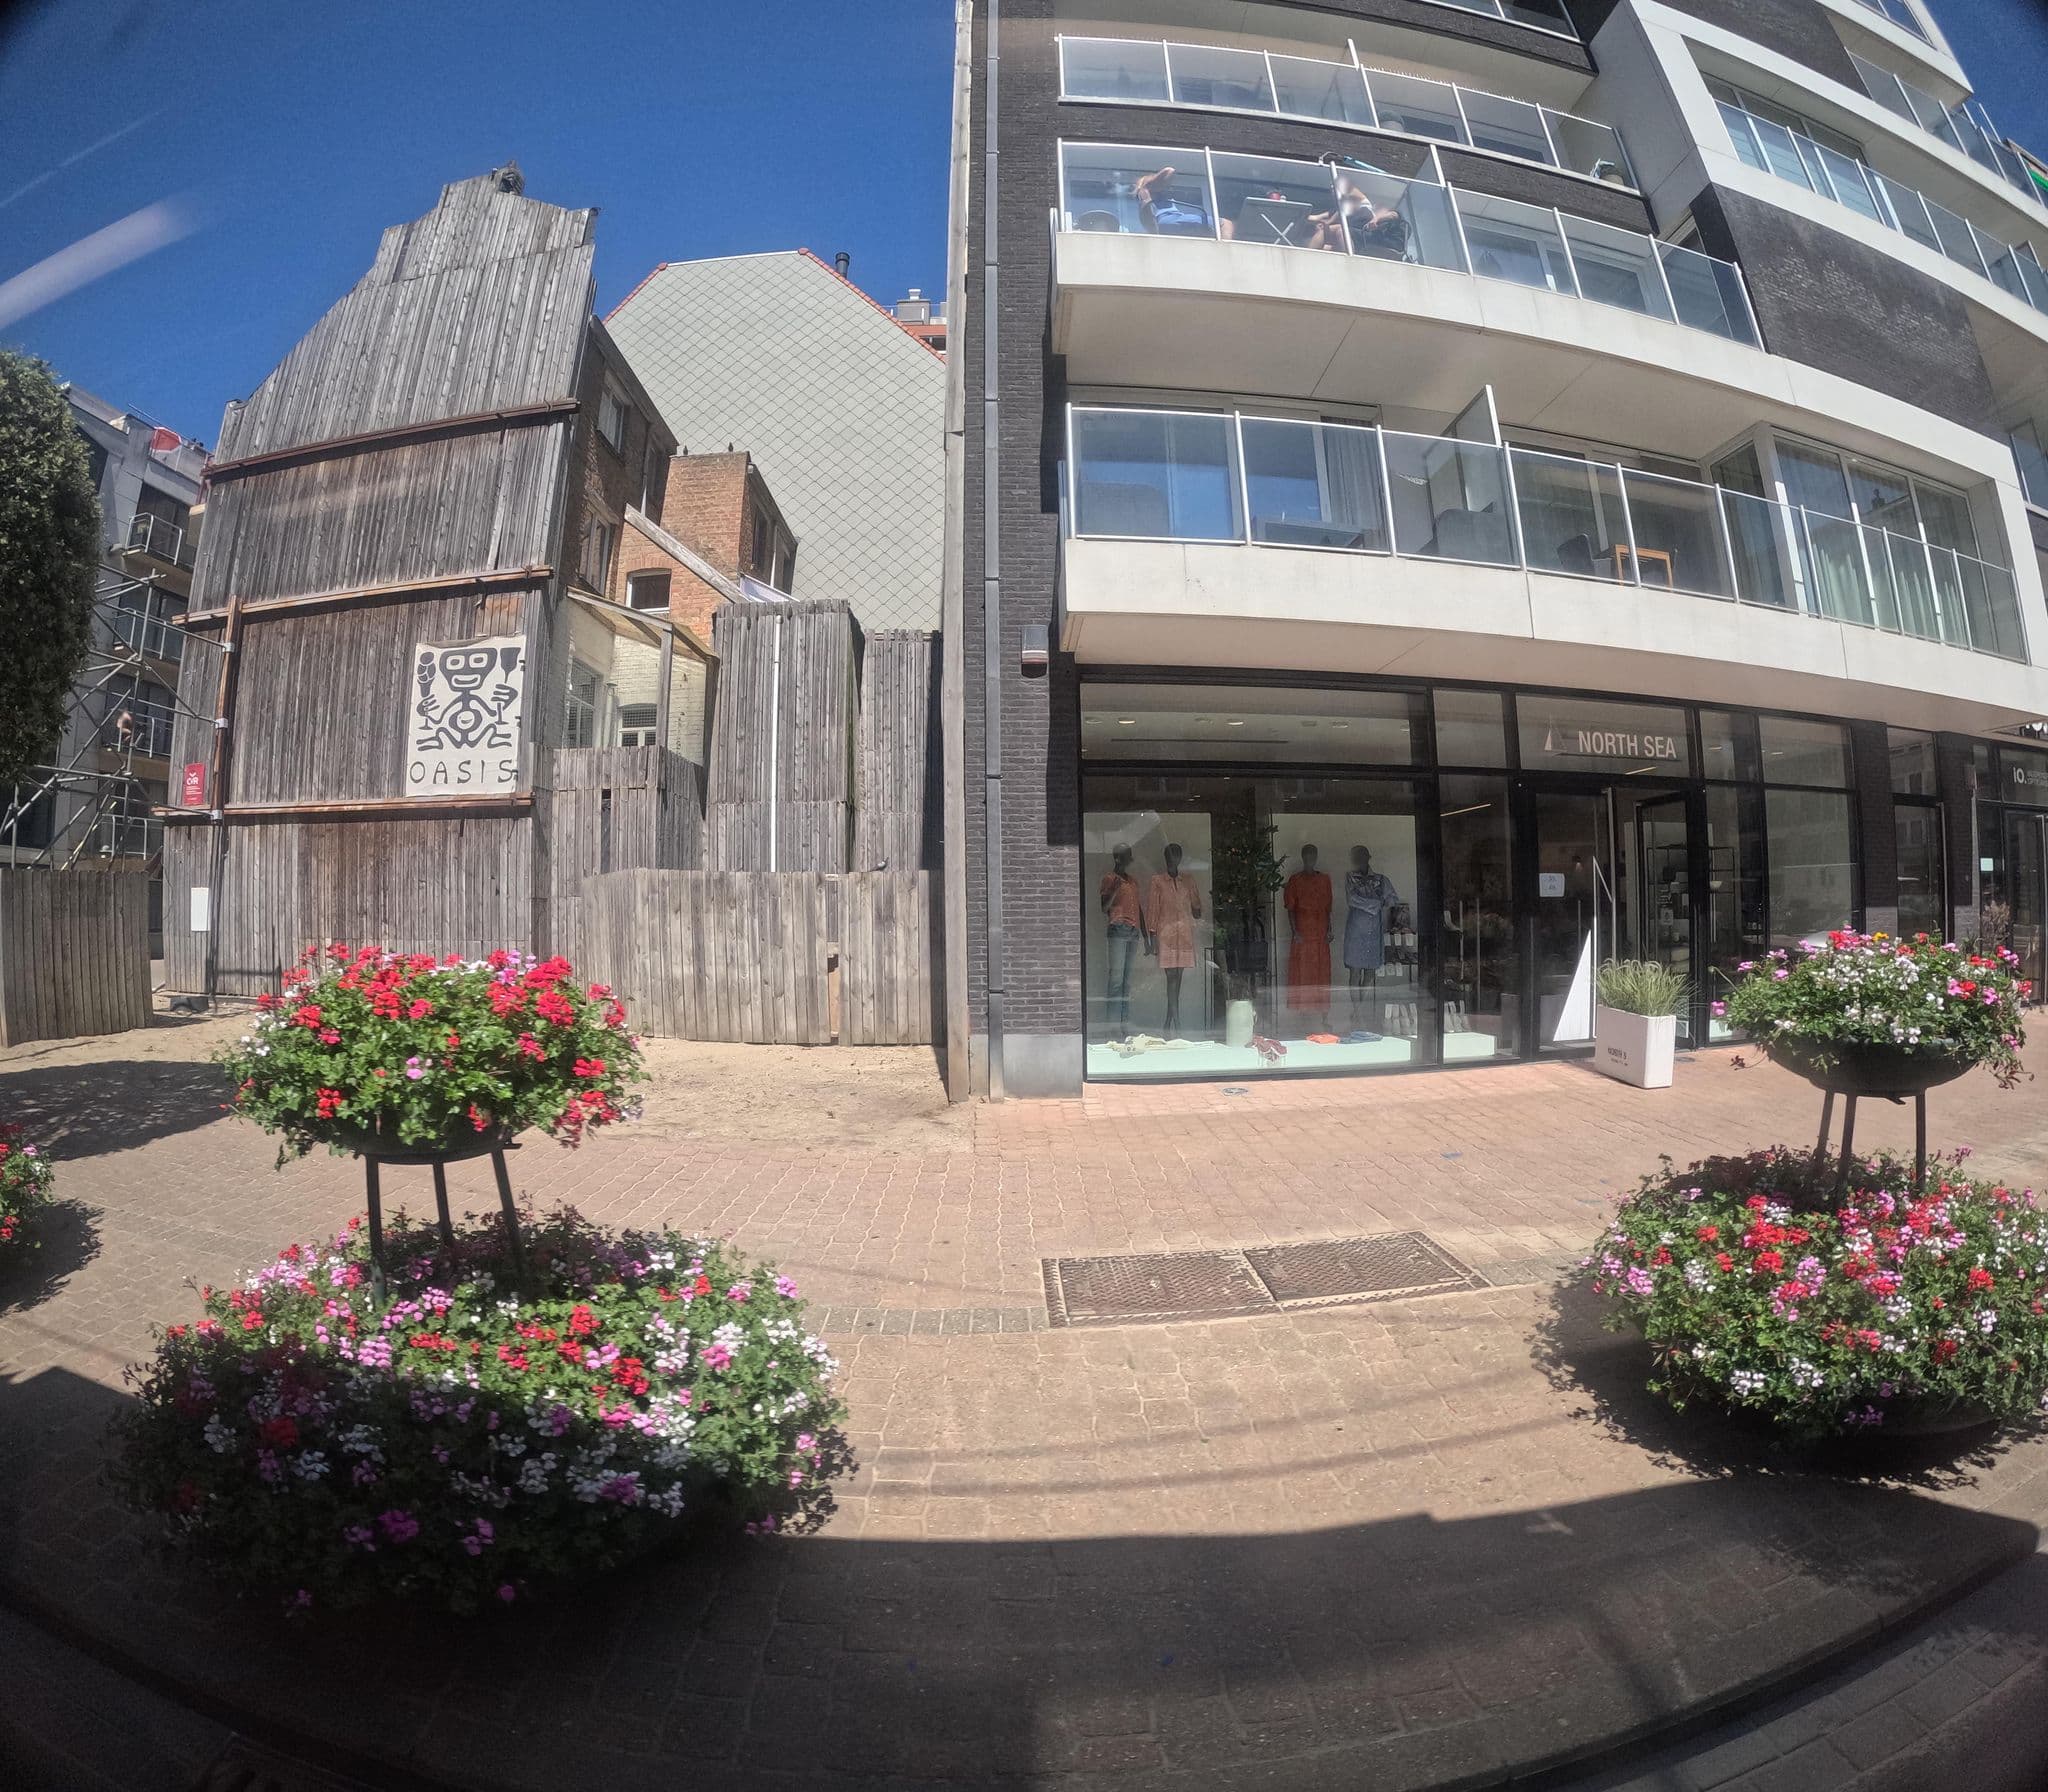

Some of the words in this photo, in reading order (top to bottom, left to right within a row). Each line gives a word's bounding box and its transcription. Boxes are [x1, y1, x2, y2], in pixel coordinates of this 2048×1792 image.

[1578, 730, 1638, 756] NORTH
[1643, 735, 1677, 759] SEA
[409, 759, 515, 785] OASIS
